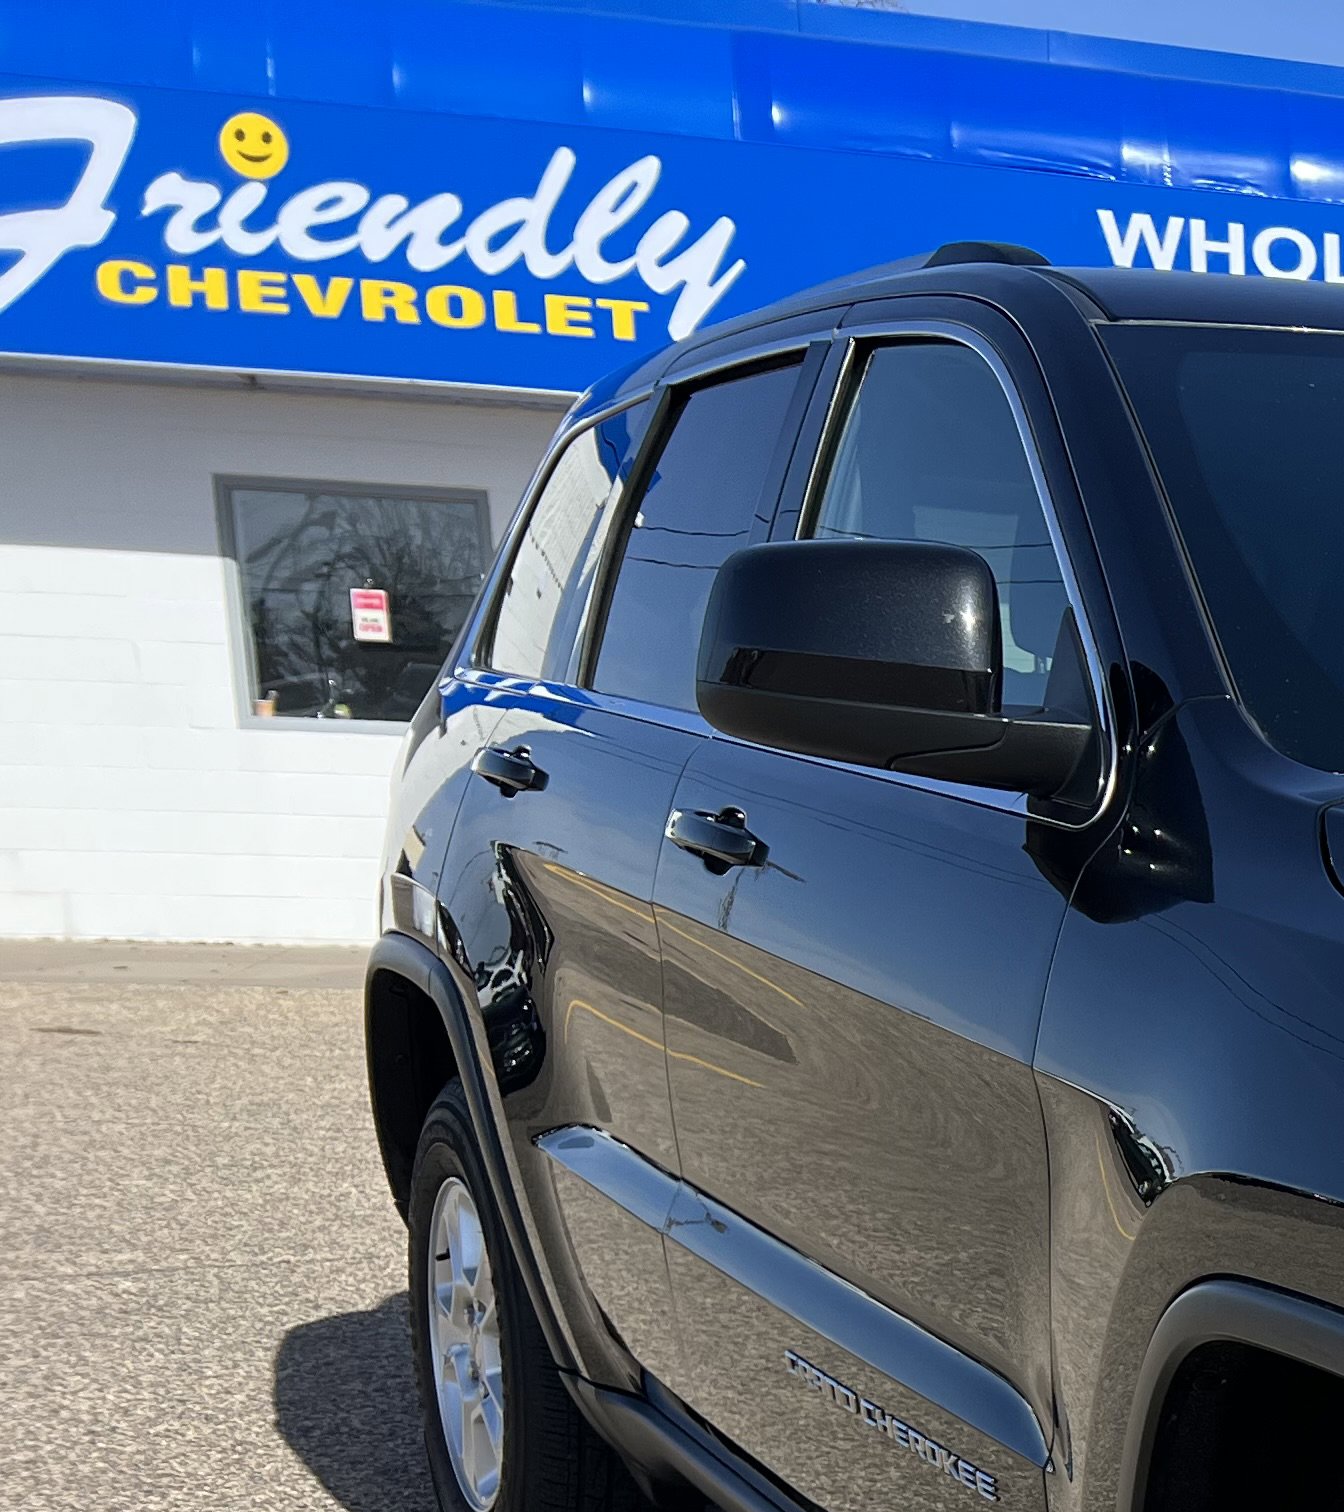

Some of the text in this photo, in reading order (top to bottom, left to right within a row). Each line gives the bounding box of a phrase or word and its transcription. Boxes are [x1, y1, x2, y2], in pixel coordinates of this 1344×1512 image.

[0, 96, 746, 341] Friendly
[96, 260, 650, 342] CHEVROLET
[860, 1398, 1001, 1501] CHEROKEE
